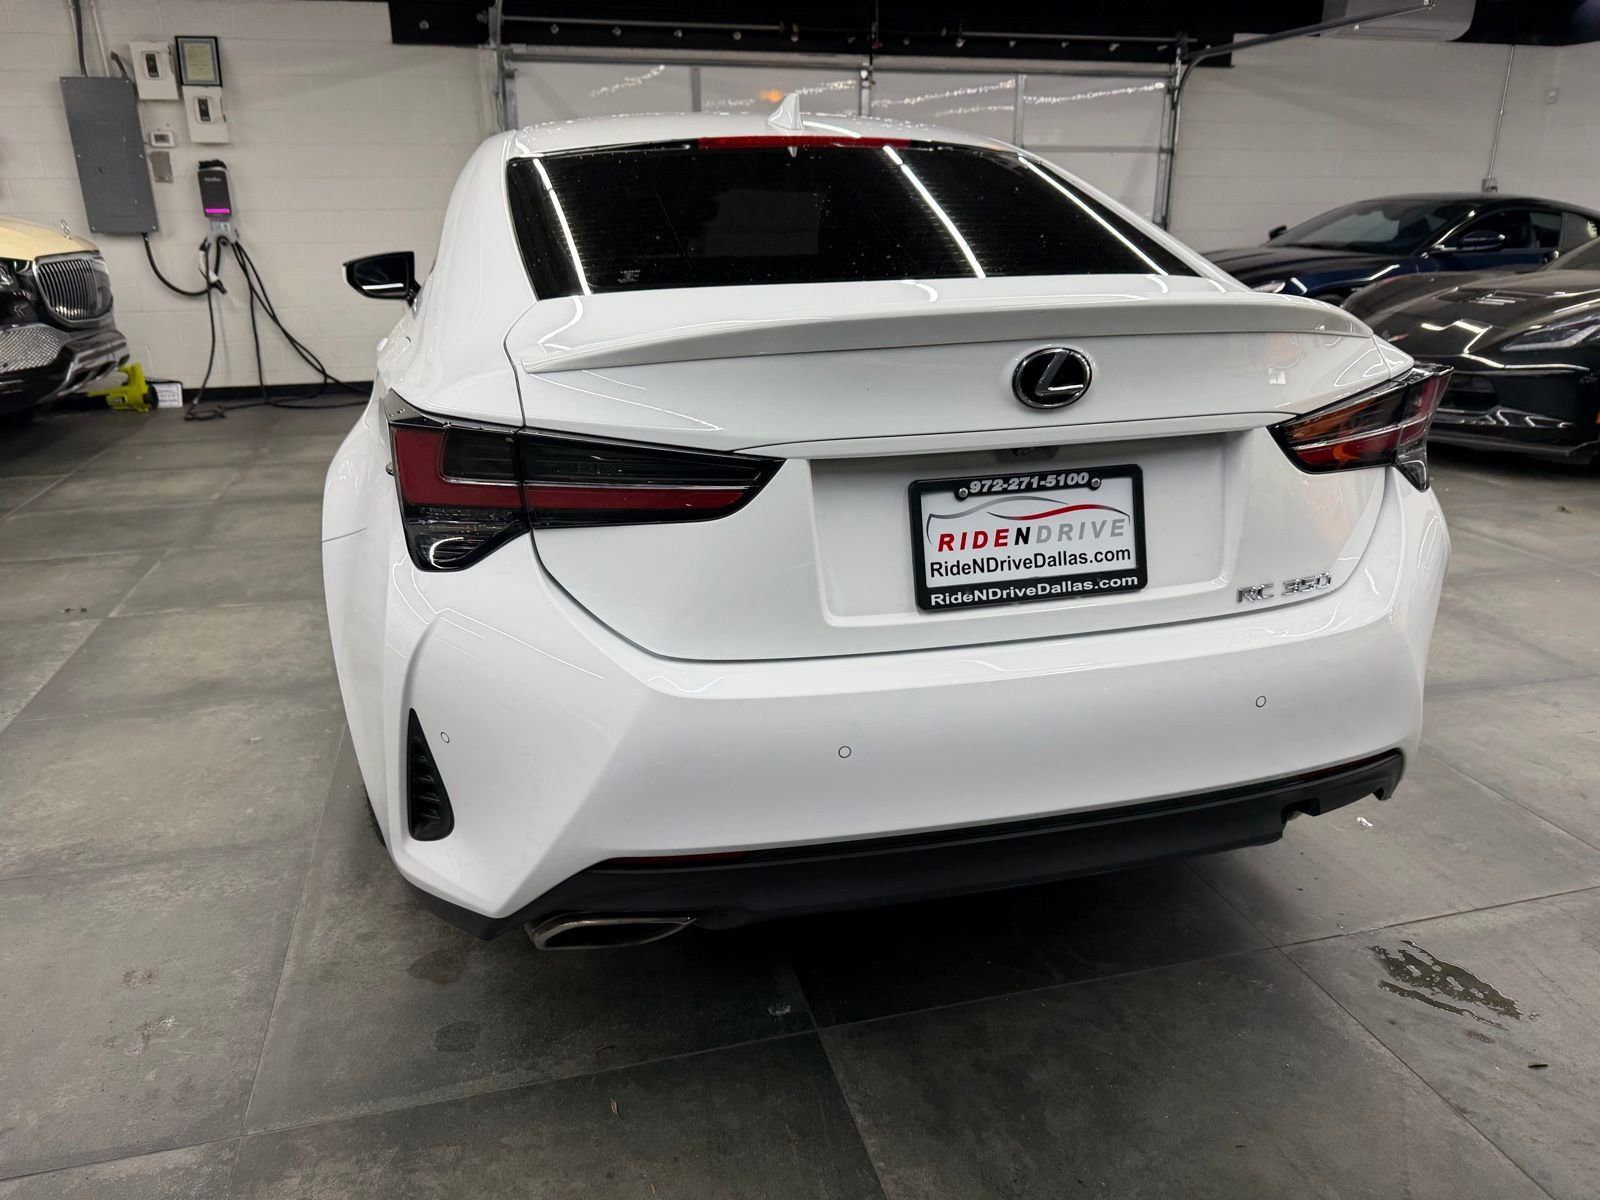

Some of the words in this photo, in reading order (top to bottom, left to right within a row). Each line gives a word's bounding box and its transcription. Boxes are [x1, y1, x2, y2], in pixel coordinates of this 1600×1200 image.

[969, 472, 1089, 494] 972-271-5100
[938, 519, 1125, 552] RIDENDRIVE
[930, 549, 1131, 578] RideNDriveDallas.com
[930, 575, 1139, 606] RideNDriveDallas.com
[1237, 583, 1274, 603] RC
[1281, 572, 1331, 596] 350
